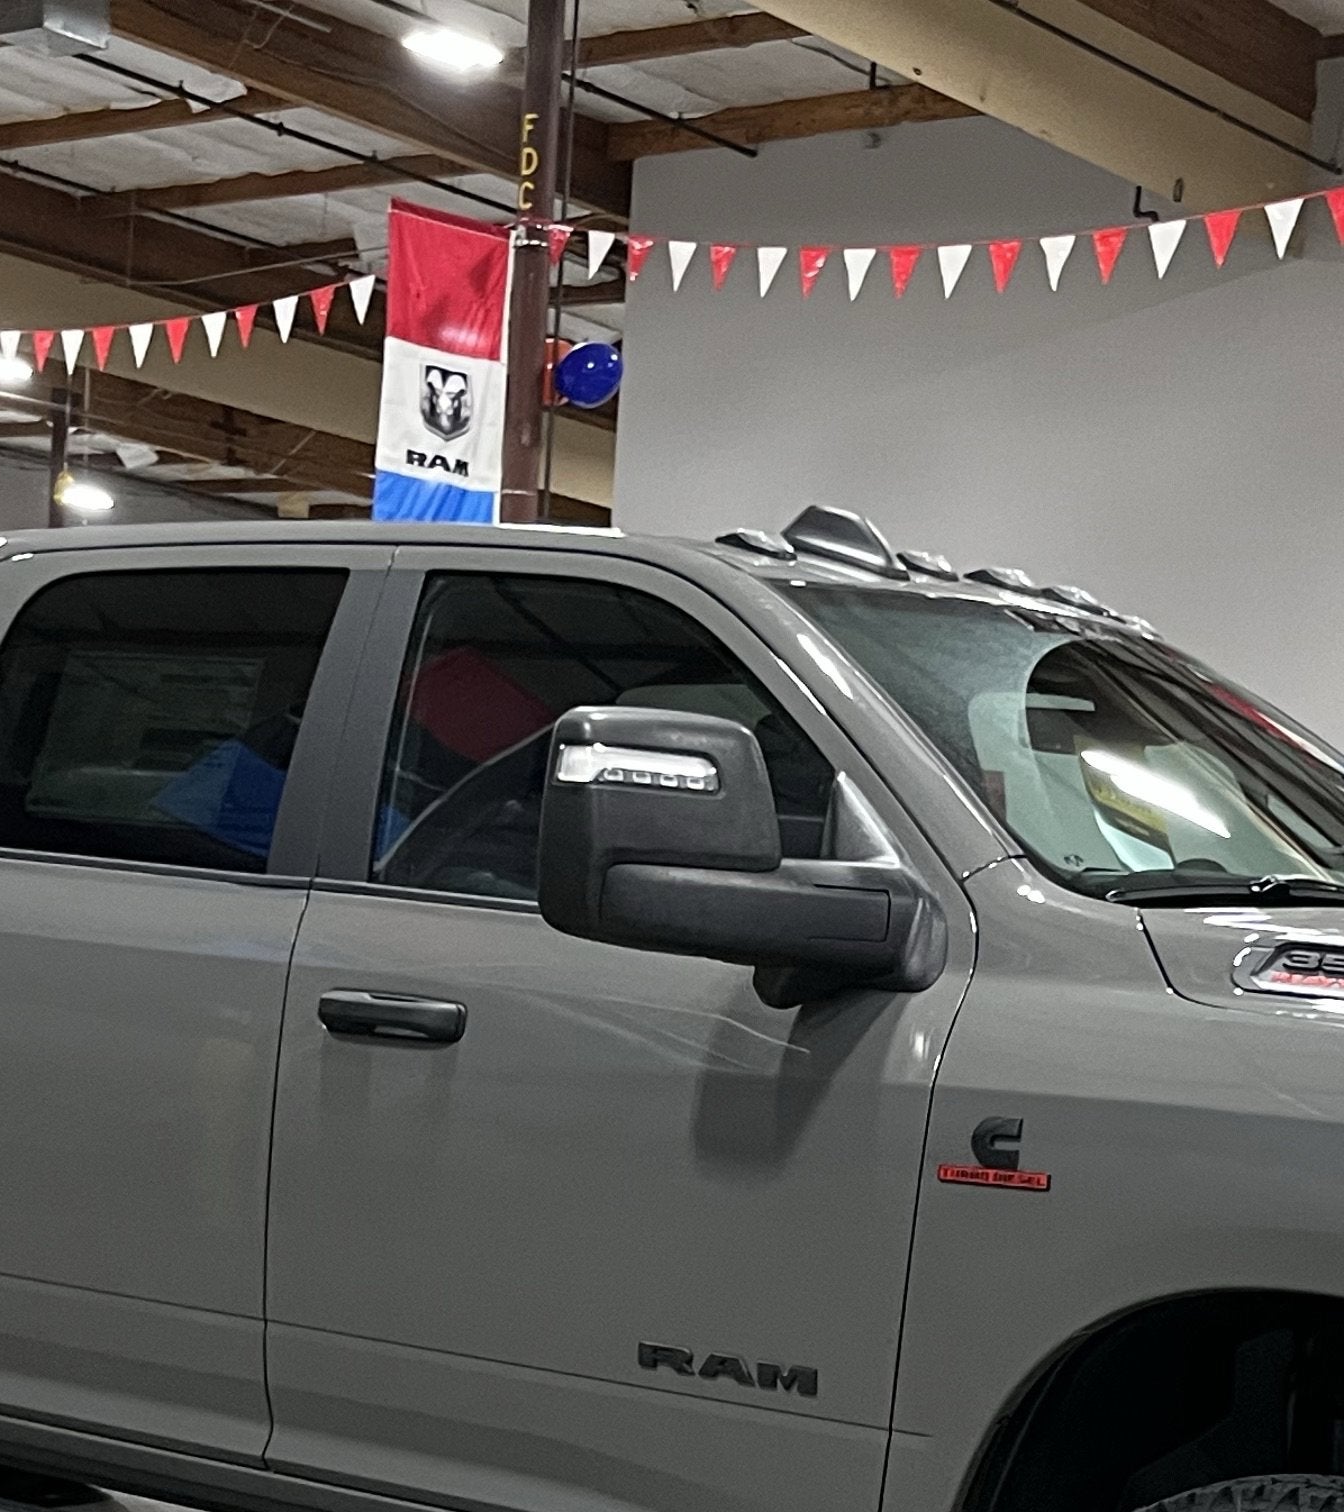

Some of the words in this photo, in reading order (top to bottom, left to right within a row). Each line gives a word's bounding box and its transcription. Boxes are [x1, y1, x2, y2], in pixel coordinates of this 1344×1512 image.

[519, 112, 540, 210] FDC
[406, 449, 469, 477] RAM
[638, 1340, 818, 1397] RAM
